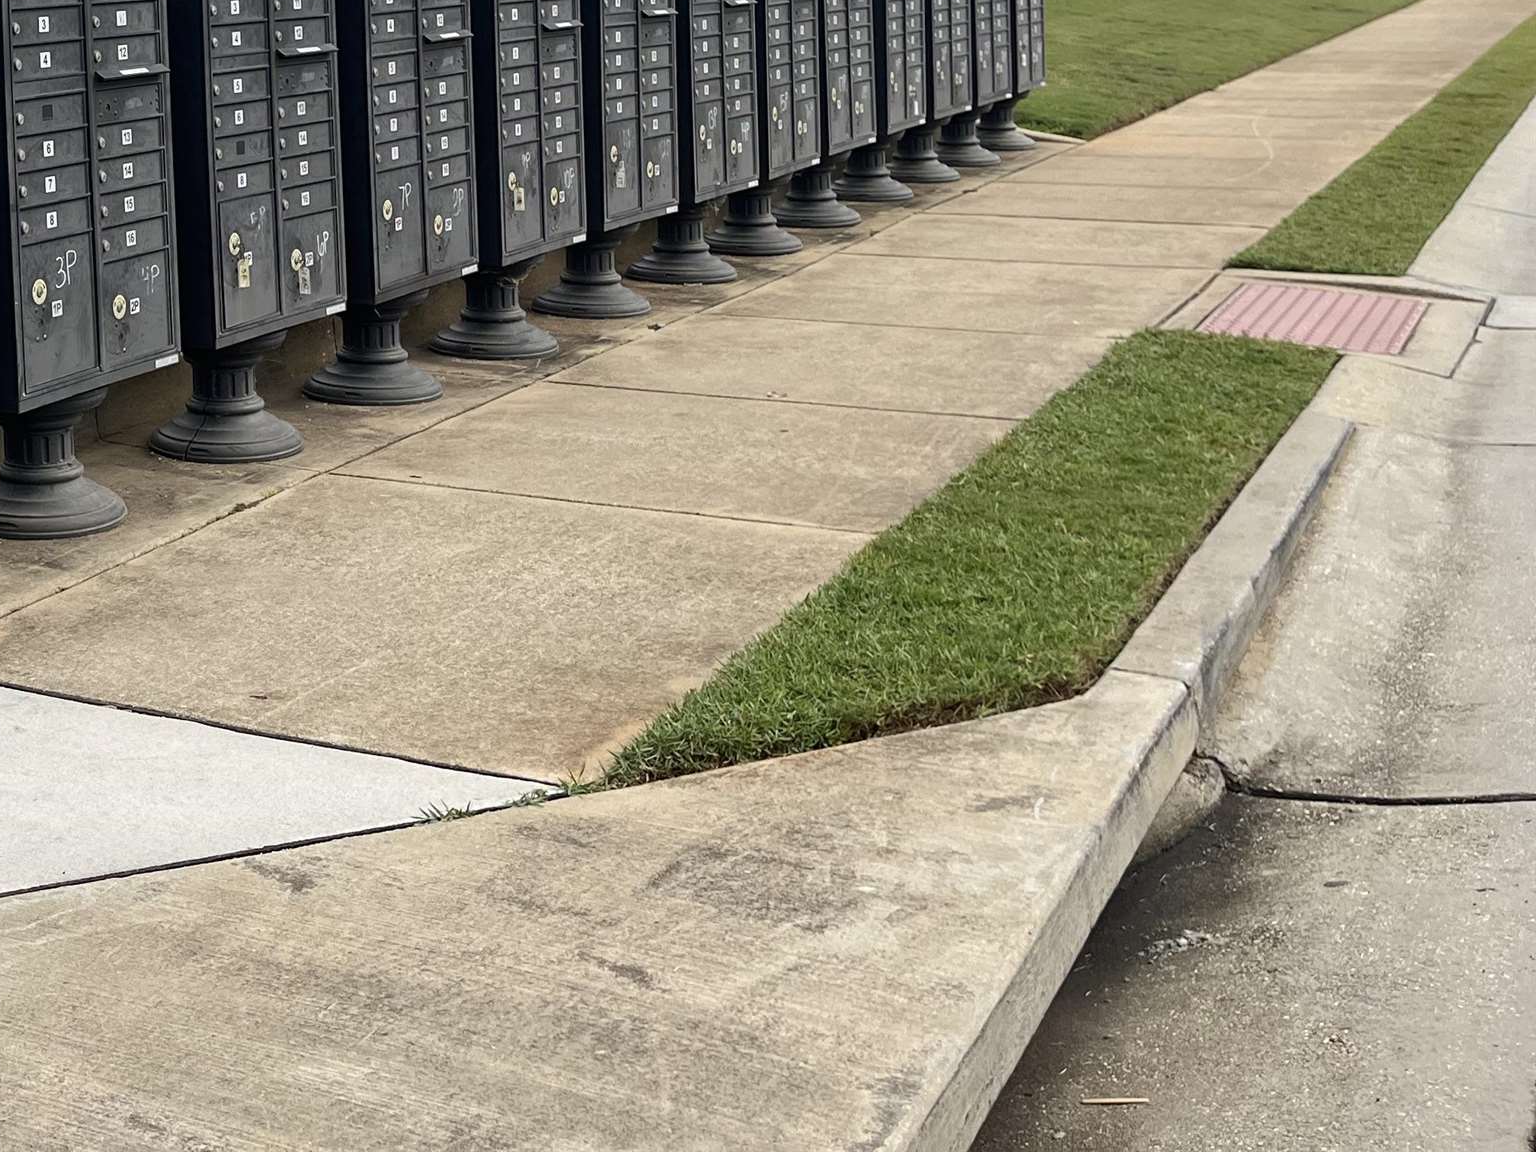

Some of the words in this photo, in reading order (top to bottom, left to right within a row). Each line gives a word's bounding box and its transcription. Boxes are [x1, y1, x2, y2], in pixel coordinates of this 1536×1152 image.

[41, 18, 47, 31] 3
[119, 46, 127, 58] 12
[42, 54, 49, 65] 4
[123, 131, 131, 143] 13
[46, 142, 52, 155] 6
[124, 164, 132, 175] 14
[47, 178, 53, 190] 7
[398, 182, 412, 211] 7P
[125, 198, 134, 210] 15
[49, 214, 55, 226] 8
[127, 232, 135, 244] 16
[55, 249, 78, 289] 3P
[52, 302, 62, 314] 1P
[130, 299, 139, 313] 2P
